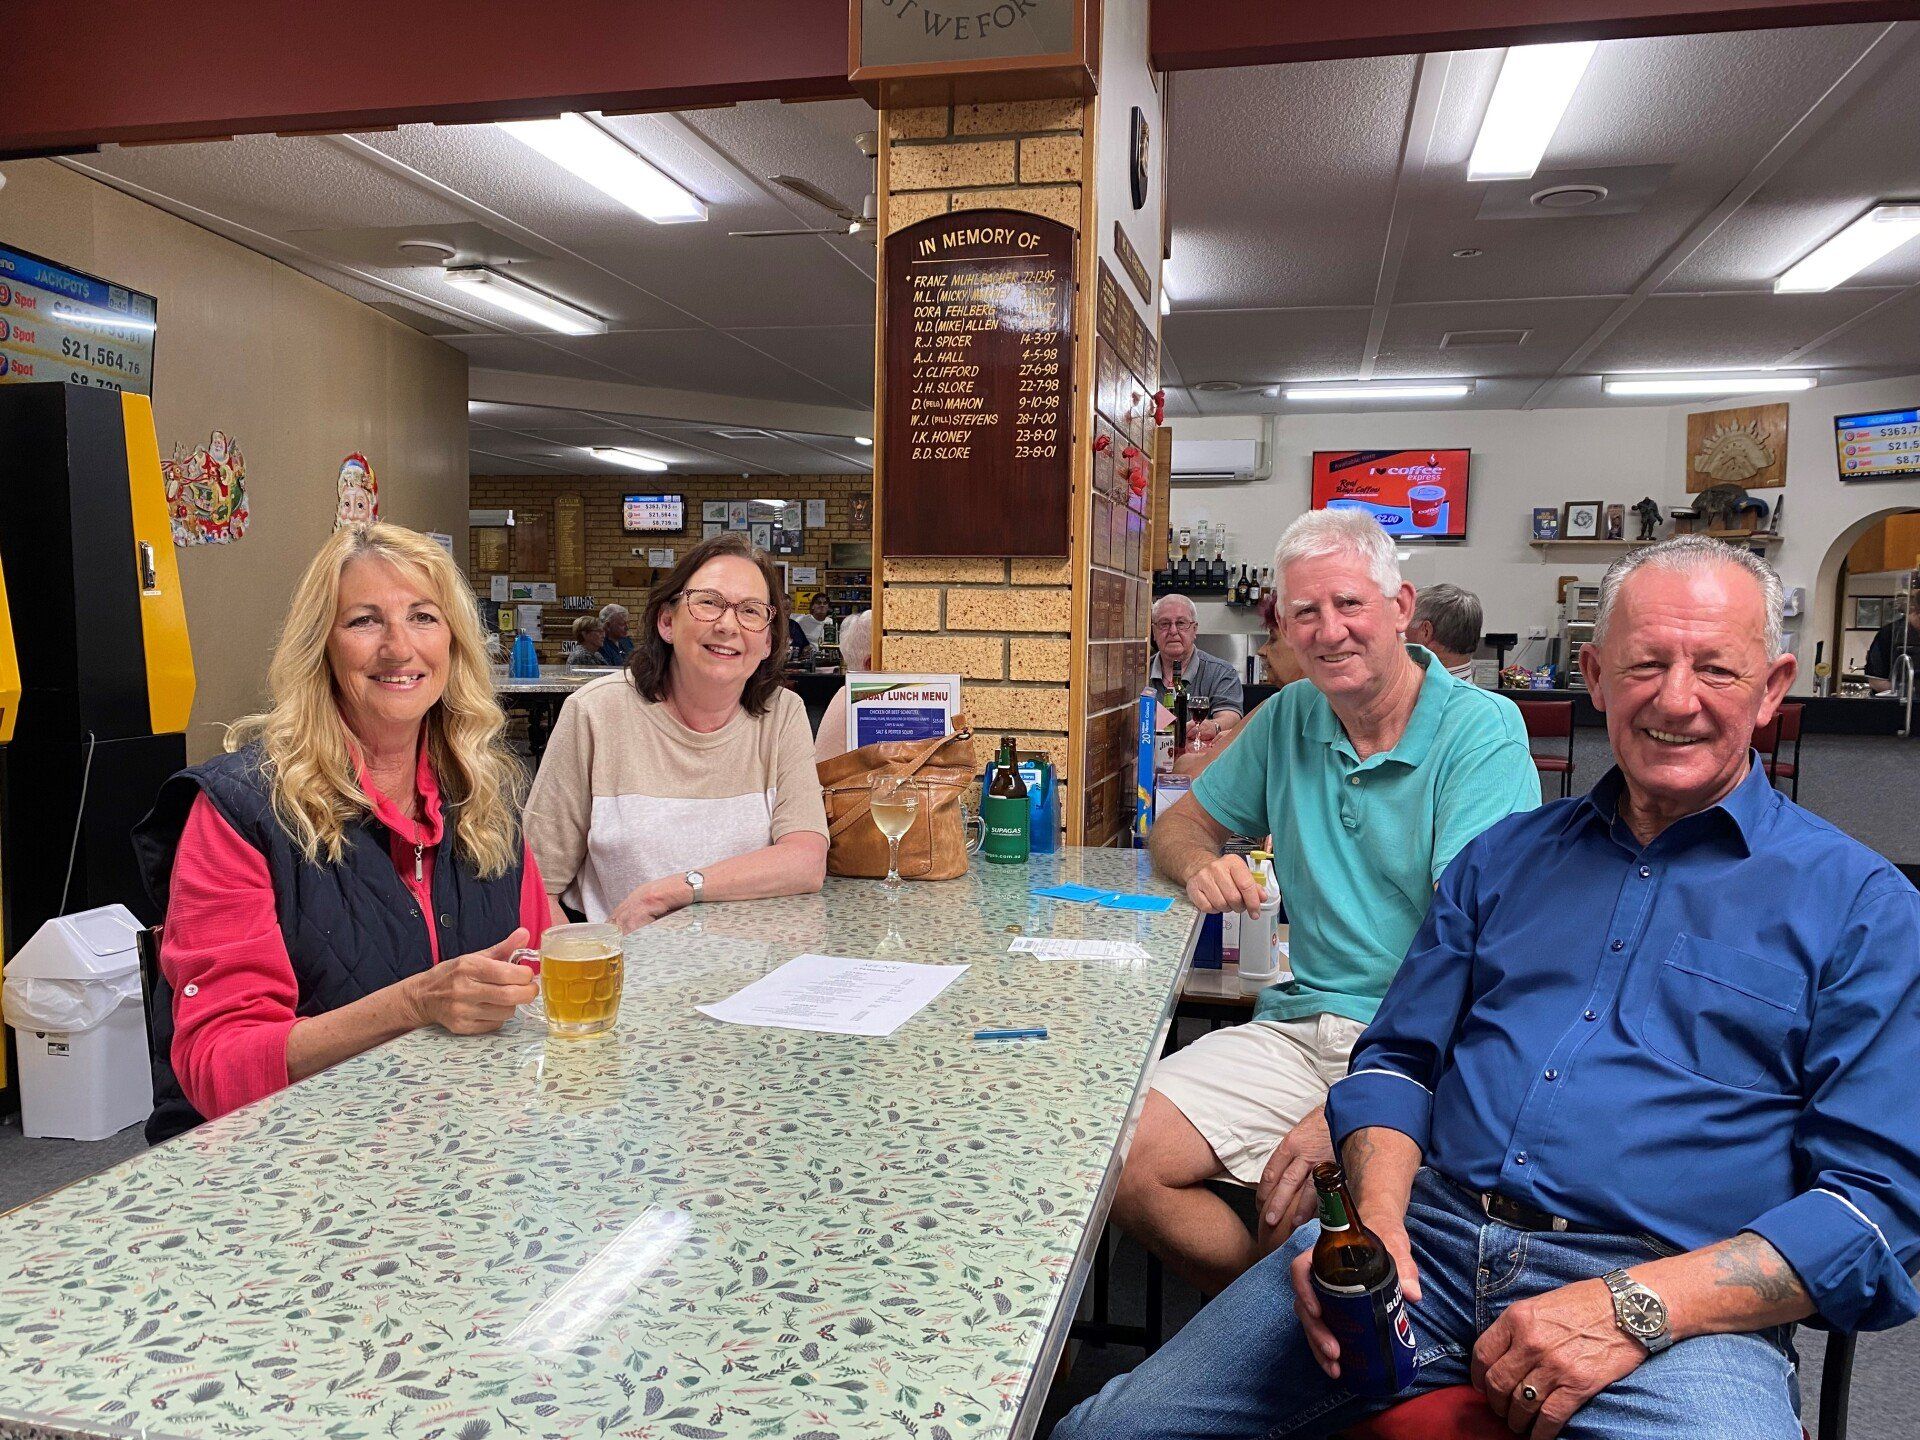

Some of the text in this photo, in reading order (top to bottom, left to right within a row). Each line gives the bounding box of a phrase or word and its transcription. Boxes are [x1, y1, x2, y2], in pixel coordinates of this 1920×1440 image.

[919, 228, 1040, 256] IN MEMORY OF
[914, 275, 948, 288] FRANZ
[14, 291, 37, 309] Spot
[913, 289, 935, 303] M.L.
[936, 288, 971, 303] (MICKY)
[914, 305, 941, 318] DORA
[945, 303, 997, 317] FEHLBERG
[914, 318, 999, 334] N.D. (MIKE) ALLEN
[914, 333, 1057, 348] R.J. SPICER 14-3-97
[12, 326, 36, 344] Spot
[62, 336, 140, 375] $21,564.76
[913, 349, 1058, 364] A.J. HALL 4-5-98
[11, 359, 34, 376] Spot
[913, 363, 1059, 378] J. CLIFFORD 27-6-98
[912, 379, 1060, 394] J.H. SLORE 22-7-98
[911, 398, 922, 410] D.
[944, 397, 984, 410] MAHON
[1018, 396, 1060, 409] 9-10-98
[910, 414, 929, 426] W.J.
[952, 414, 999, 426] STEVENS
[1016, 412, 1057, 425] 28-1-00
[912, 429, 1057, 444] I.K. HONEY 23-8-01
[912, 446, 1057, 460] B.D. SLORE 23-8-01
[1387, 465, 1442, 475] coffee
[1407, 474, 1441, 482] express
[562, 596, 594, 610] BILLIARDS
[888, 691, 919, 701] LUNCH
[921, 691, 948, 701] MENU
[1141, 733, 1151, 745] 20
